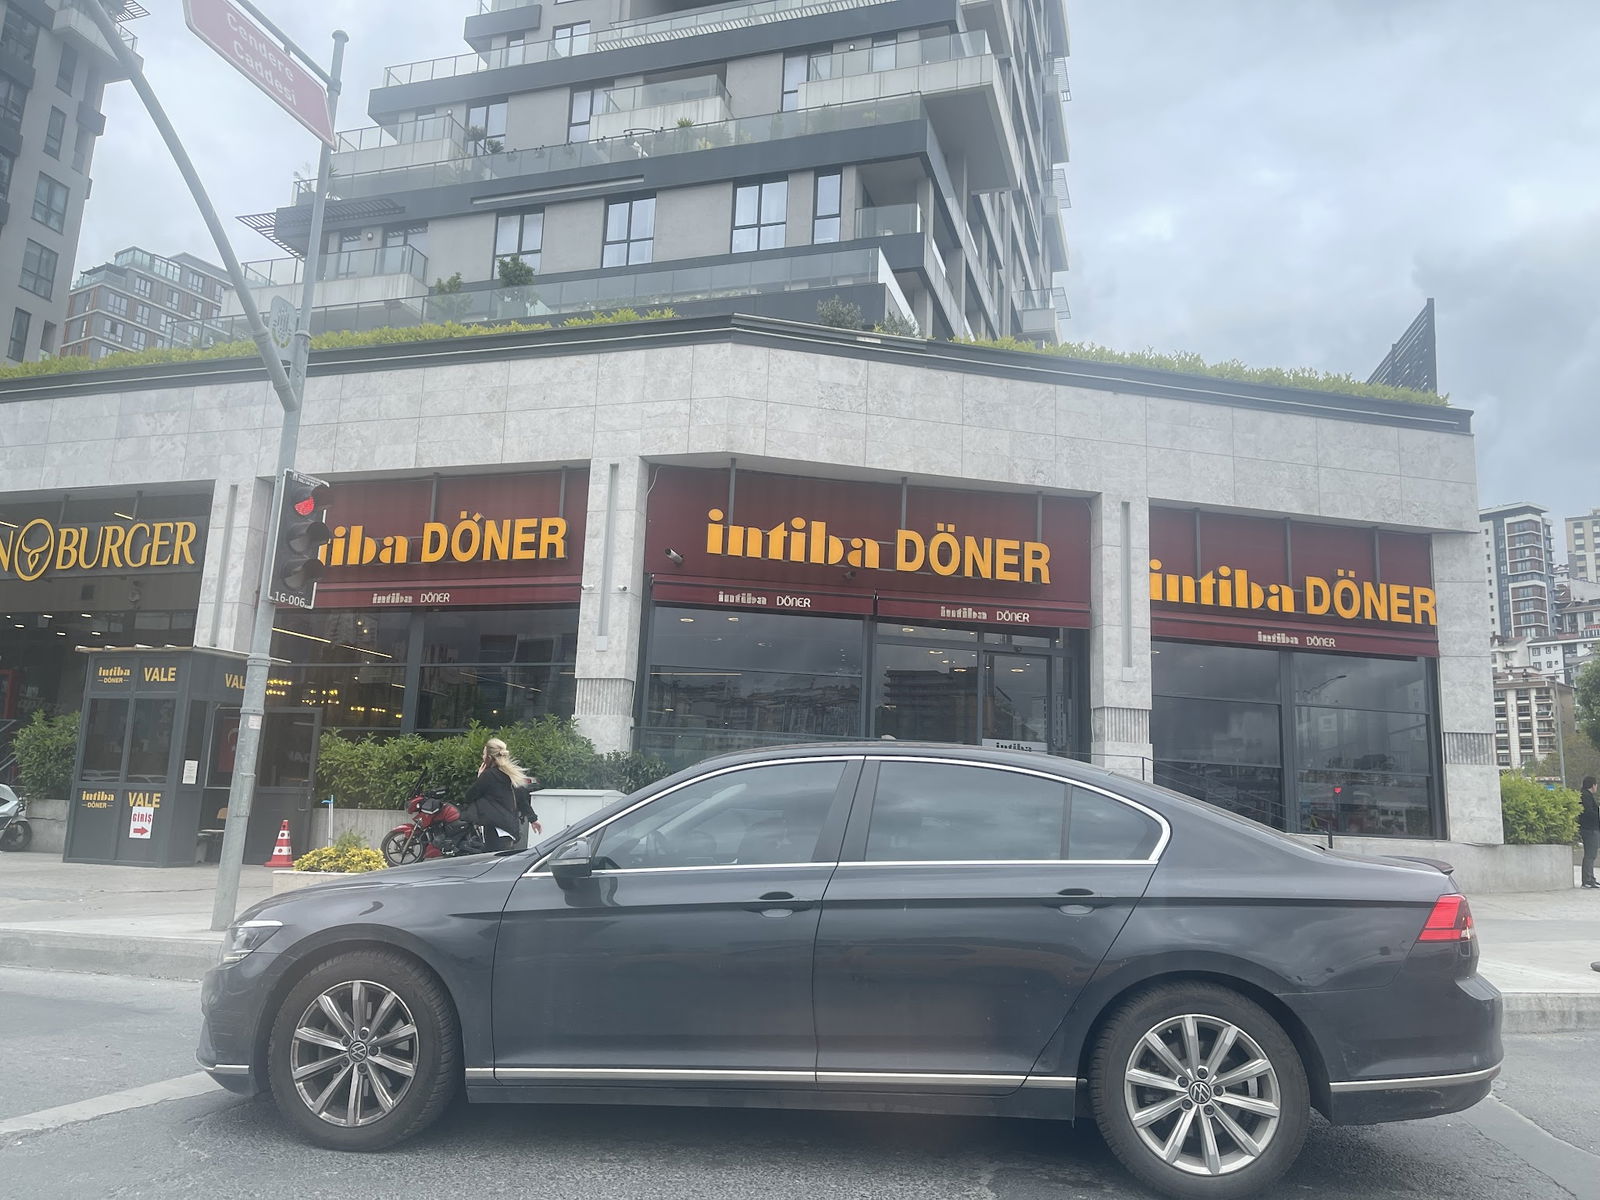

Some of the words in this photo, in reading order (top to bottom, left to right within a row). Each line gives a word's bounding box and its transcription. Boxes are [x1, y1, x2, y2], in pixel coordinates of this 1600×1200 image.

[227, 12, 294, 82] Cendere
[233, 40, 297, 106] Caddesi
[420, 510, 567, 563] DÖNER
[706, 508, 880, 569] intiba
[896, 523, 1051, 584] DÖNER
[372, 593, 413, 604] intiba
[420, 591, 450, 603] DÖNER
[718, 591, 767, 605] intiba
[776, 595, 811, 608] DÖNER
[1149, 559, 1295, 613] intiba
[1305, 569, 1437, 626] DÖNER
[940, 606, 987, 619] intiba
[996, 610, 1030, 623] DÖNER
[1257, 631, 1299, 645] intiba
[1306, 635, 1336, 647] DÖNER
[98, 667, 131, 677] intiba
[144, 667, 177, 682] VALE
[225, 673, 246, 690] VAL
[82, 791, 115, 801] intiba
[128, 792, 161, 808] VALE
[87, 801, 107, 809] DÖNER
